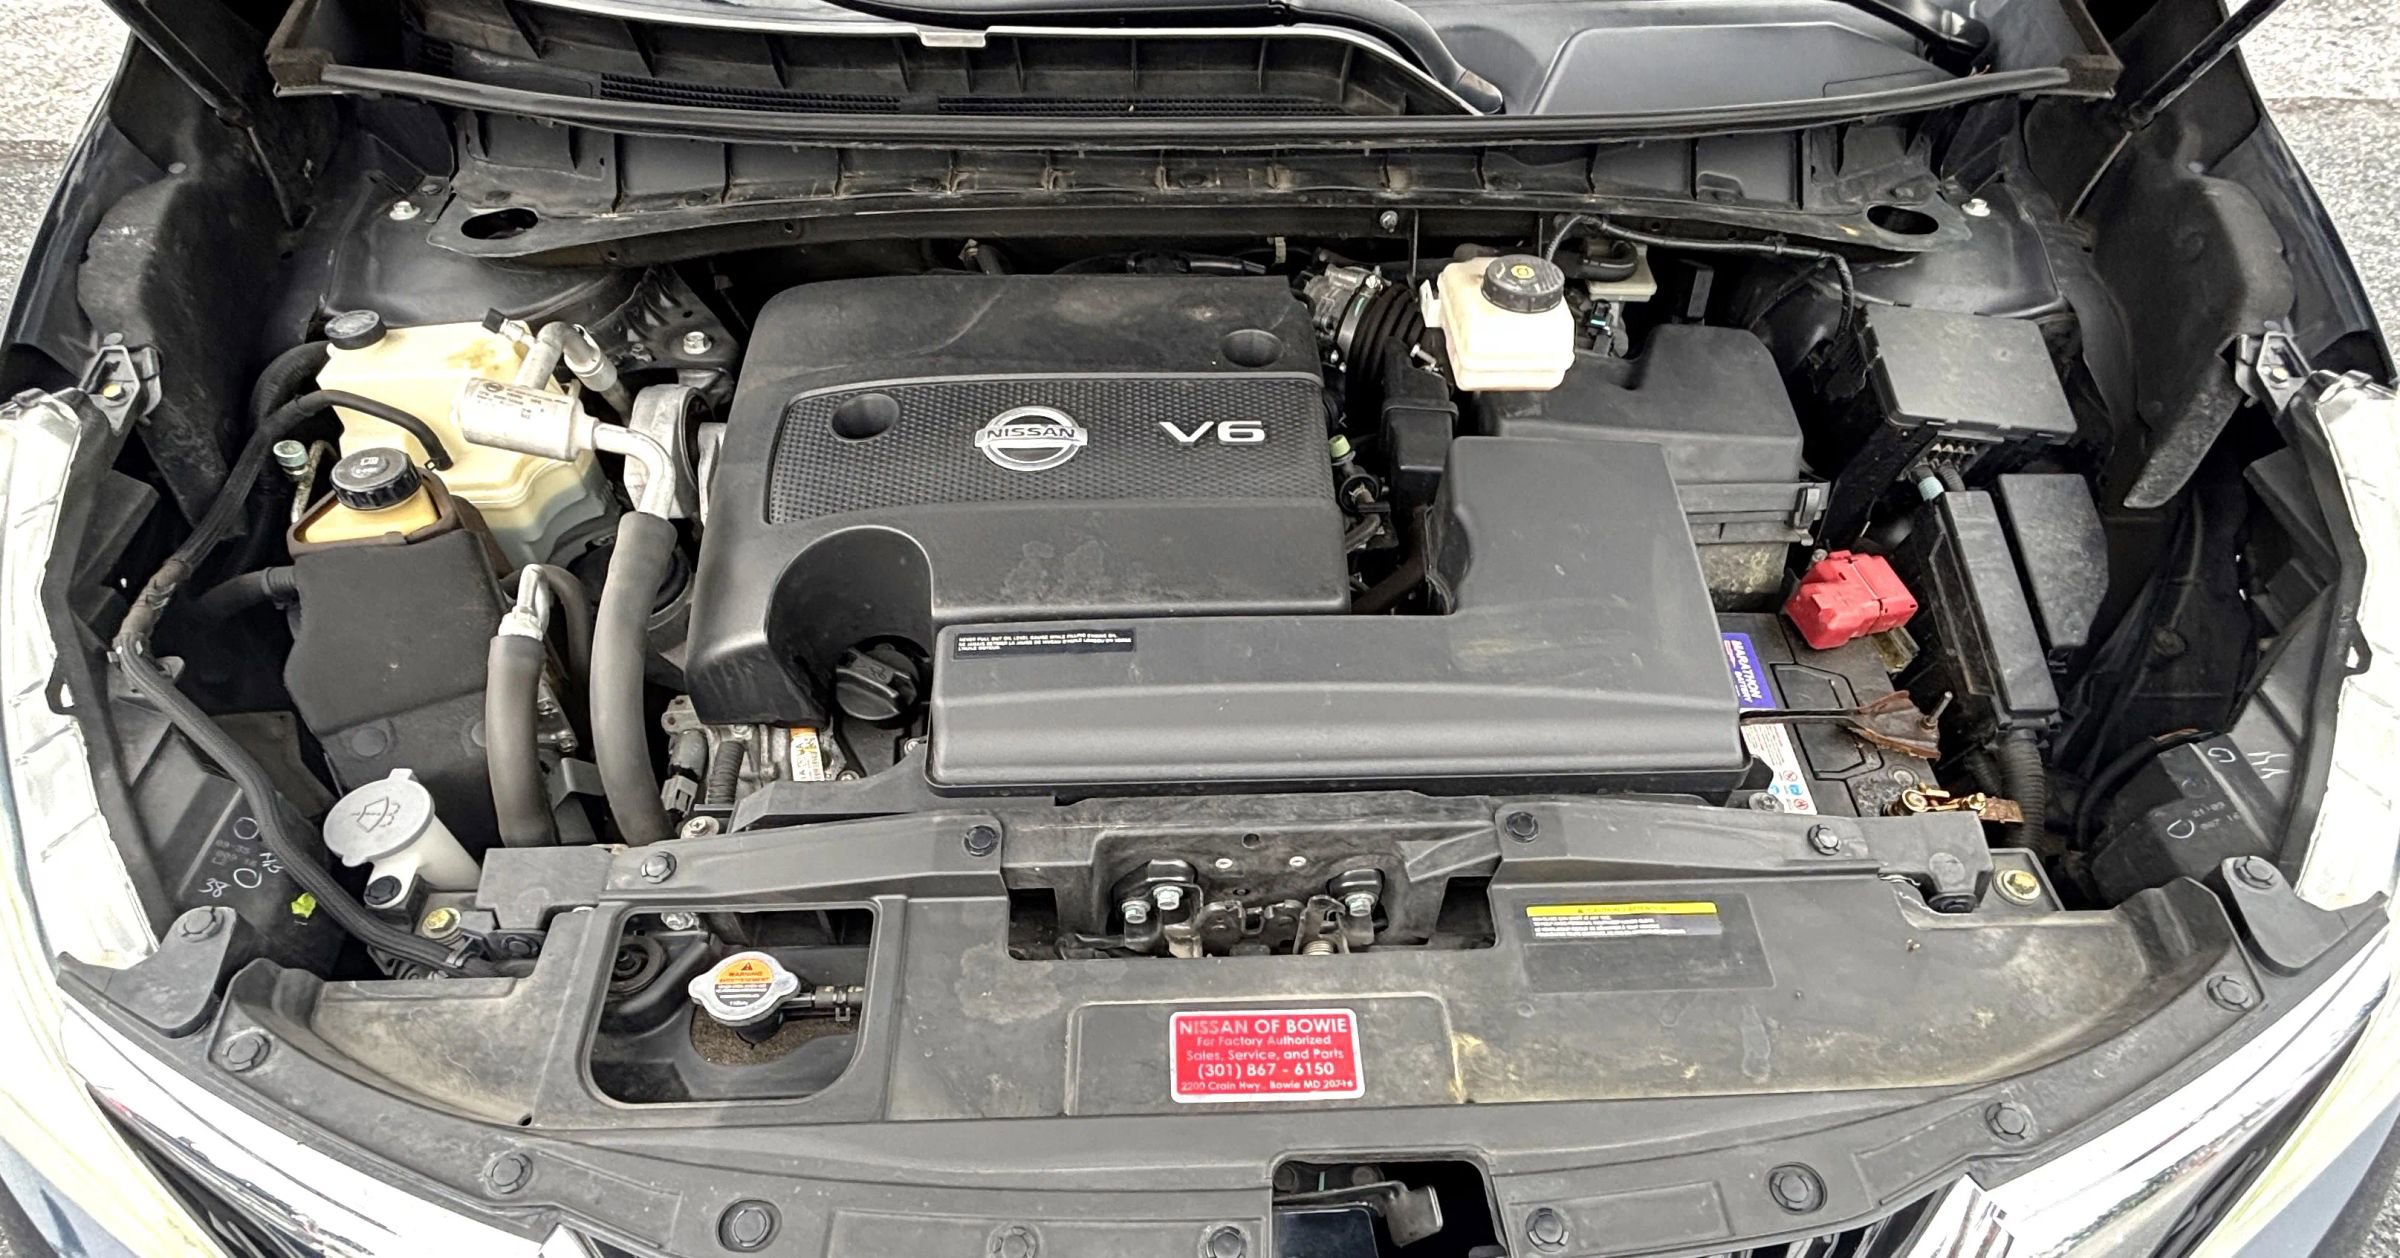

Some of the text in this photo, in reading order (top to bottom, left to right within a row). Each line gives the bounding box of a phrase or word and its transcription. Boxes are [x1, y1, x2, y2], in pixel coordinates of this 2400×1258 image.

[987, 427, 1075, 439] NISSAN
[1158, 420, 1266, 446] V6
[1731, 639, 1762, 699] MARATHON
[1179, 1018, 1347, 1035] NISSAN OF BOWIE
[1197, 1035, 1331, 1047] For Factory Authorized
[1186, 1048, 1344, 1061] Sales, Service, and Parts
[1197, 1063, 1242, 1079] (301)
[1247, 1063, 1276, 1076] 867
[1294, 1062, 1334, 1076] 6150
[1207, 1081, 1237, 1091] Crain
[1269, 1080, 1300, 1090] Bowie
[1303, 1080, 1321, 1089] MD
